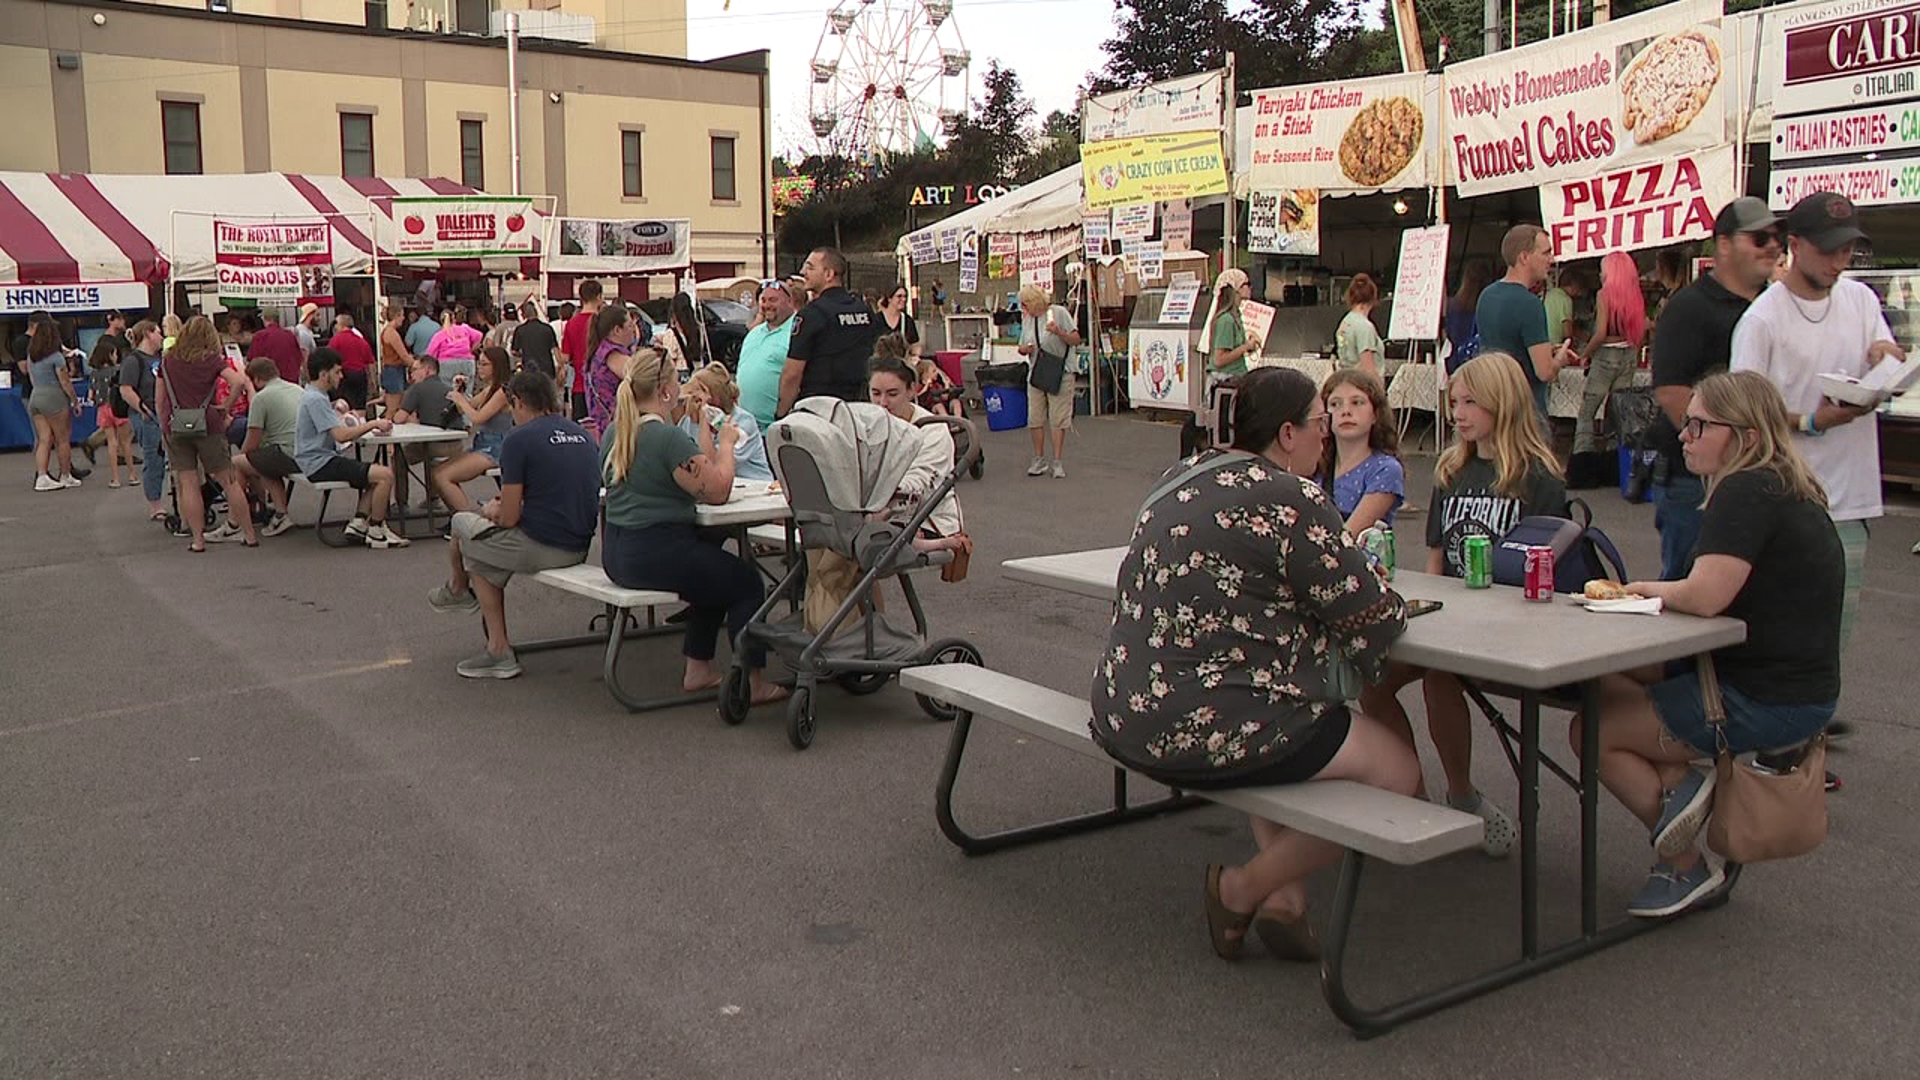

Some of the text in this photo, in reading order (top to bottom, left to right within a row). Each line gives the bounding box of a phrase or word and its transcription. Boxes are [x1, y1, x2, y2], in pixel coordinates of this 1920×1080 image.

[1829, 12, 1920, 71] CAR
[1450, 52, 1612, 119] Webby's Homemade
[1866, 72, 1915, 97] ITALIAN
[1257, 86, 1363, 117] Teriyaki Chicken
[1255, 115, 1314, 138] on a Stick
[1786, 109, 1920, 152] ITALIAN PASTRIES CA
[1253, 146, 1334, 165] Over Seasoned Rice
[1453, 110, 1617, 182] Funnel Cakes
[1125, 155, 1220, 180] CRAZY COW ICE CREAM
[1561, 157, 1702, 217] PIZZA
[1847, 168, 1891, 201] ZEPPOLI
[910, 185, 955, 205] ART
[1252, 191, 1277, 211] Deep
[436, 214, 497, 230] VALENTI'S
[1249, 211, 1276, 228] Fried
[1551, 196, 1715, 257] FRITTA
[220, 226, 325, 244] THE ROYAL BAKERY
[626, 241, 674, 257] PIZZERIA
[1021, 247, 1051, 260] BROCCOLI
[1021, 260, 1051, 271] SAUSAGE
[219, 269, 300, 285] CANNOLIS
[6, 287, 101, 305] HANDEL'S
[220, 286, 300, 295] FILLED FRESH IN SECONDS
[838, 312, 871, 326] POLICE
[550, 435, 588, 445] CHOSEN
